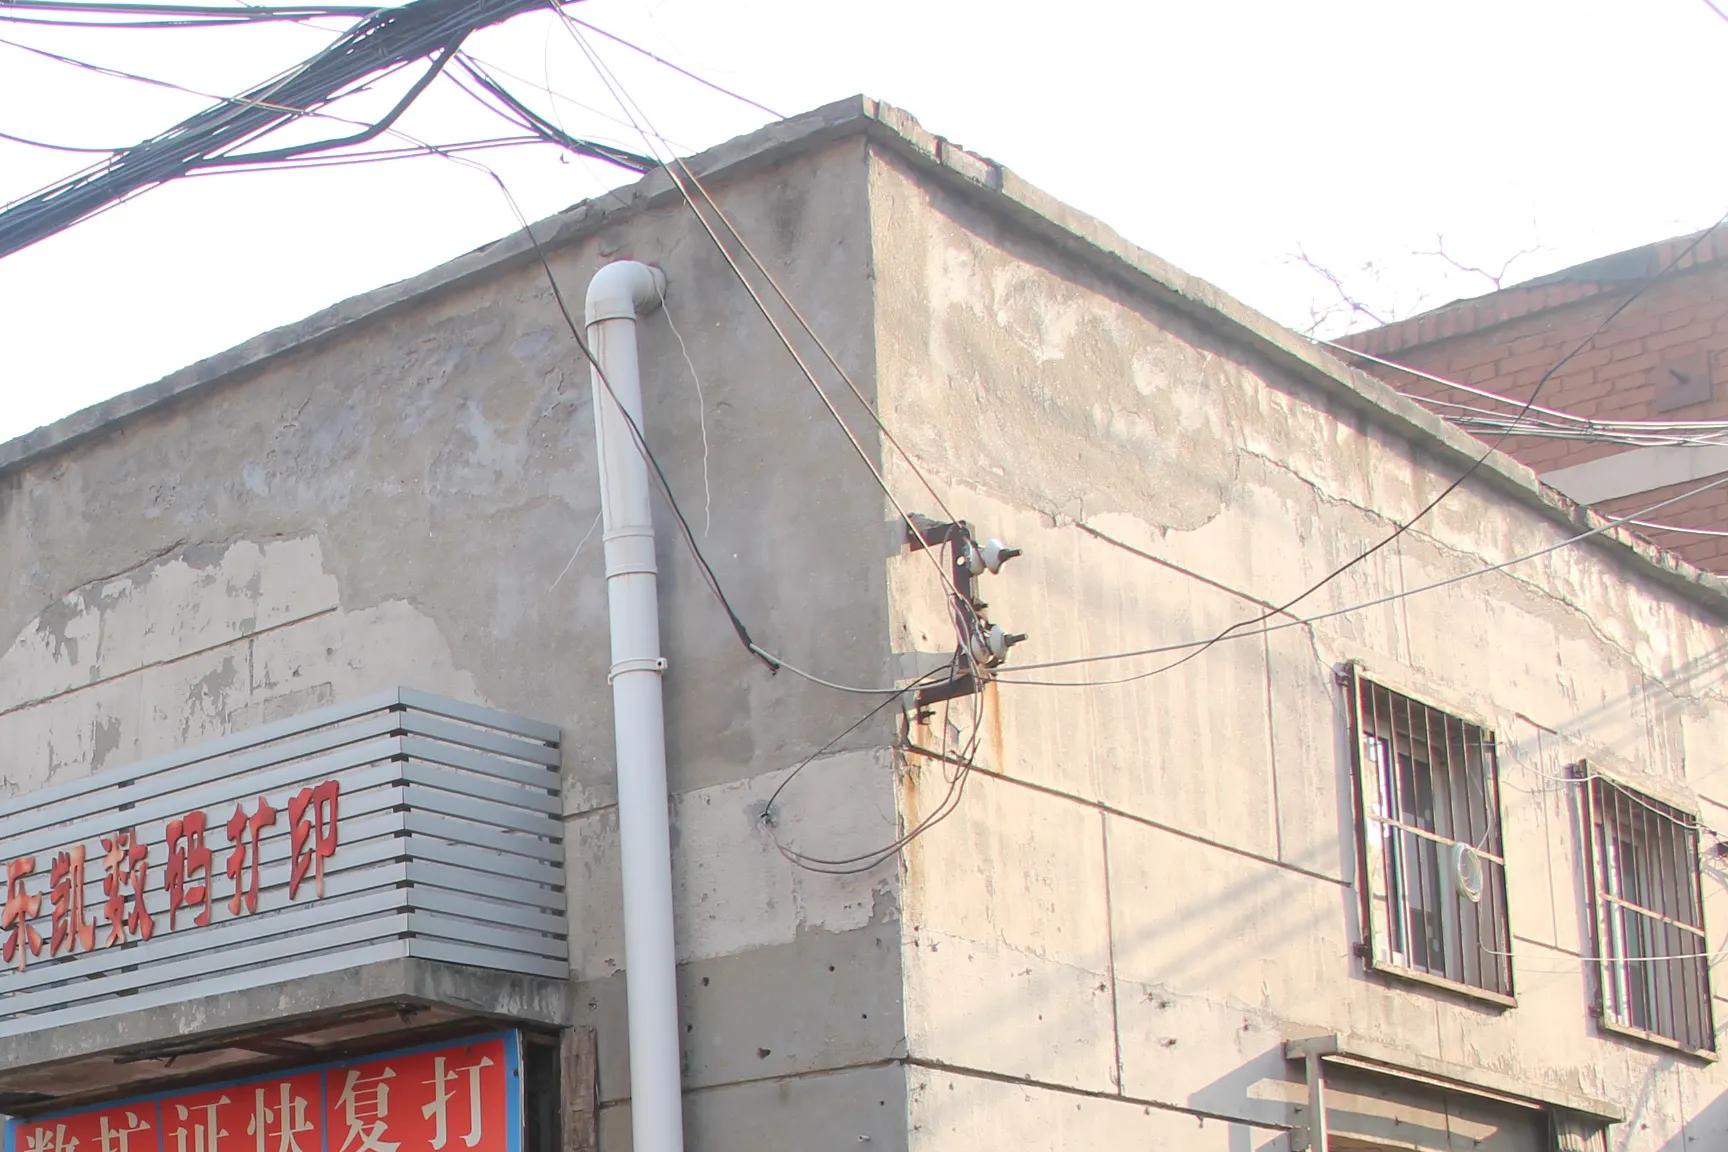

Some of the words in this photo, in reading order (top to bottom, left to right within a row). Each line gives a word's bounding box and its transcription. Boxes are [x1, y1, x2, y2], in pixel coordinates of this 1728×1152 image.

[2, 780, 340, 972] 乐凯数码扩印
